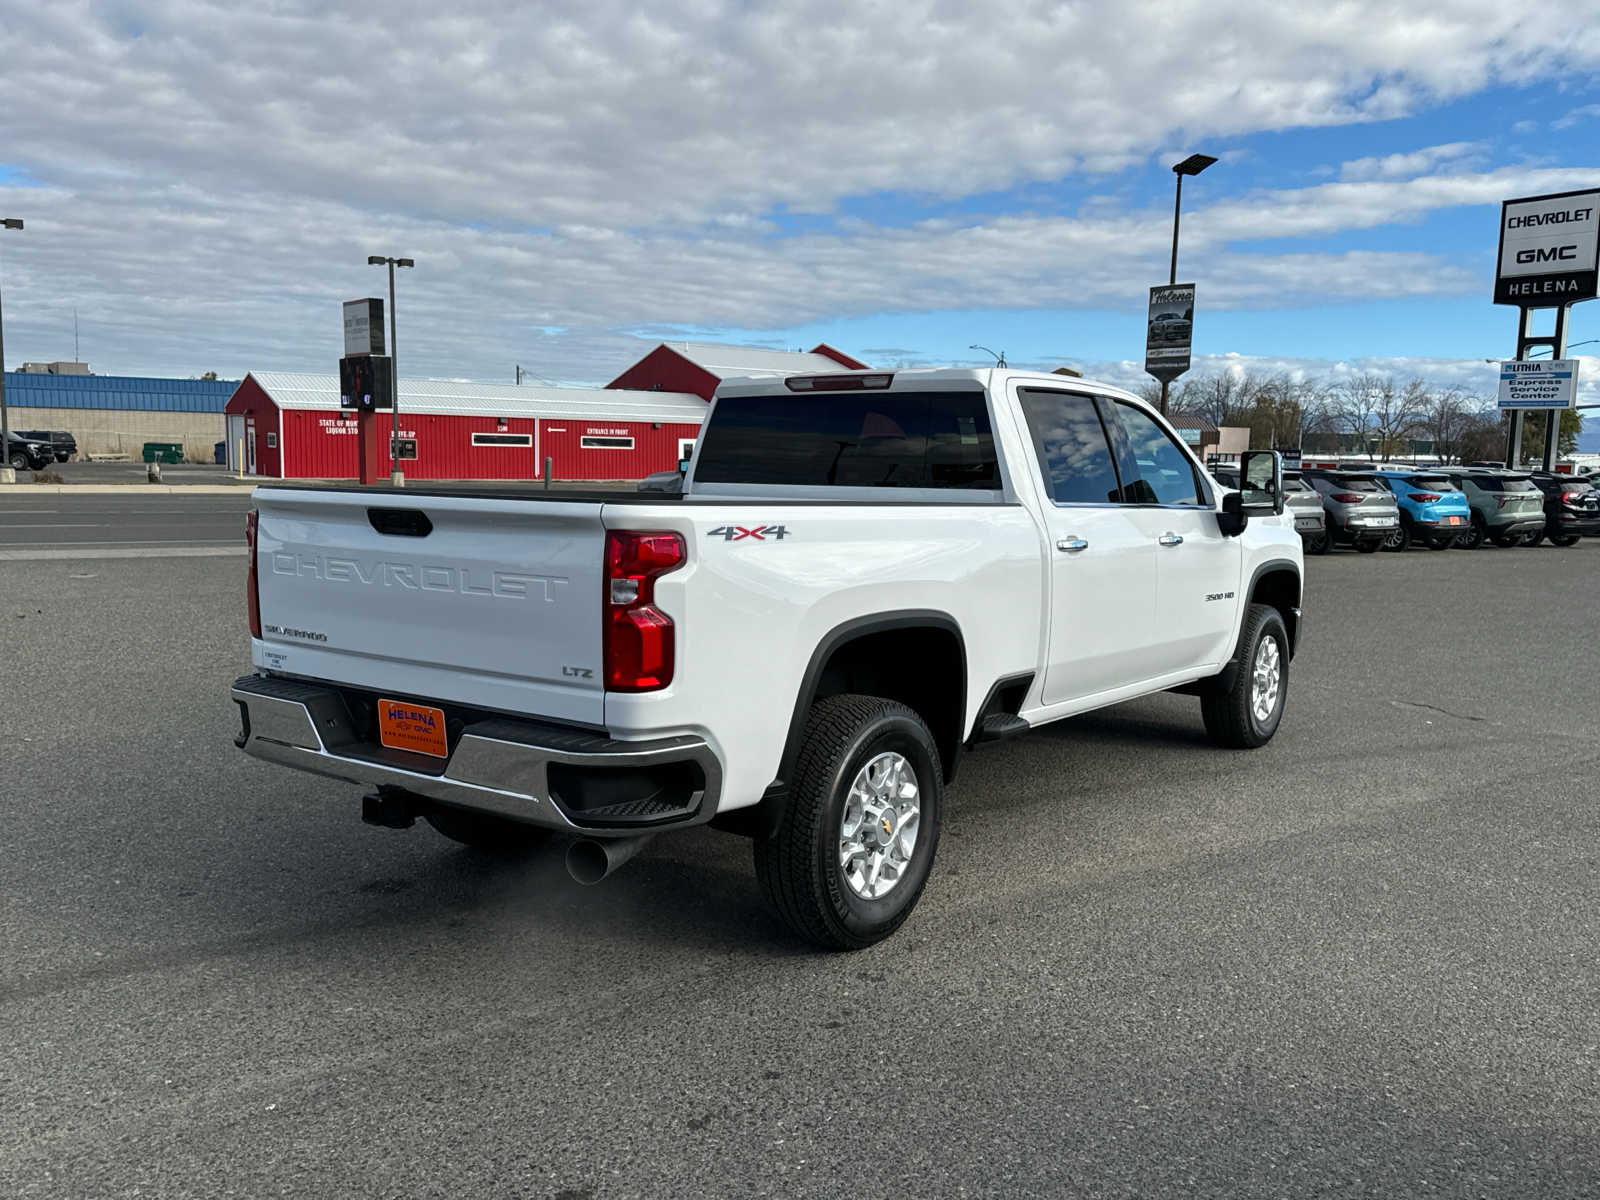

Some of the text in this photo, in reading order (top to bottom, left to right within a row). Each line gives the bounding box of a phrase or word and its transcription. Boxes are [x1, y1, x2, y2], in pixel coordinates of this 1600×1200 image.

[1508, 208, 1593, 229] CHEVROLET
[1516, 245, 1577, 264] GMC
[1509, 280, 1578, 295] HELENA
[1512, 363, 1541, 372] LITHIA
[319, 419, 336, 427] STATE
[326, 427, 359, 435] LIQUOR STO
[272, 552, 569, 602] CHEVROLET
[1205, 593, 1223, 602] 3500
[264, 624, 328, 642] SILVERADO
[562, 665, 593, 679] LTZ
[388, 708, 435, 728] HELENA
[414, 726, 433, 735] GMC
